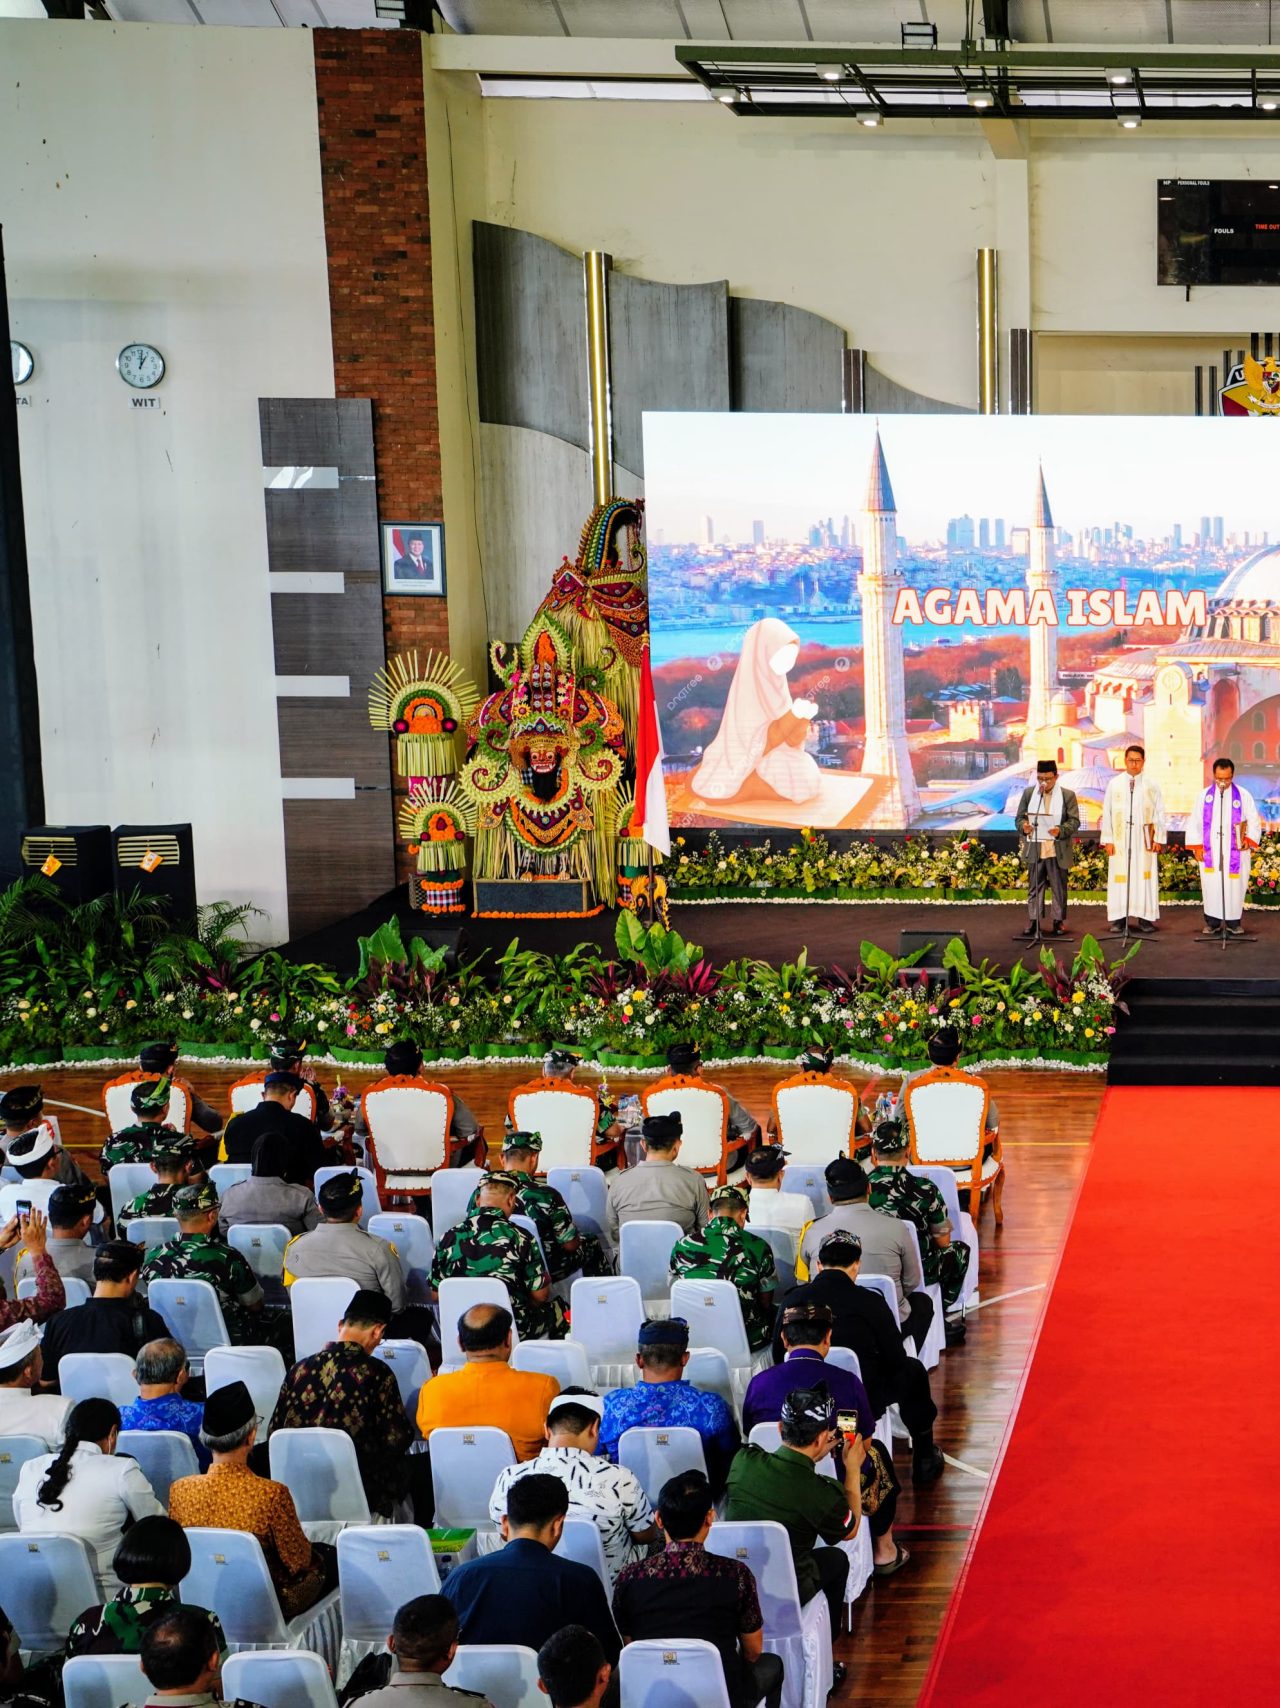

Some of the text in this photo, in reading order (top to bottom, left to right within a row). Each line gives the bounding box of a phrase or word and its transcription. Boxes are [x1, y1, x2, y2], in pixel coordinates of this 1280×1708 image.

[16, 397, 29, 405] TA
[131, 398, 156, 407] WIT
[892, 587, 1207, 627] AGAMA ISLAM
